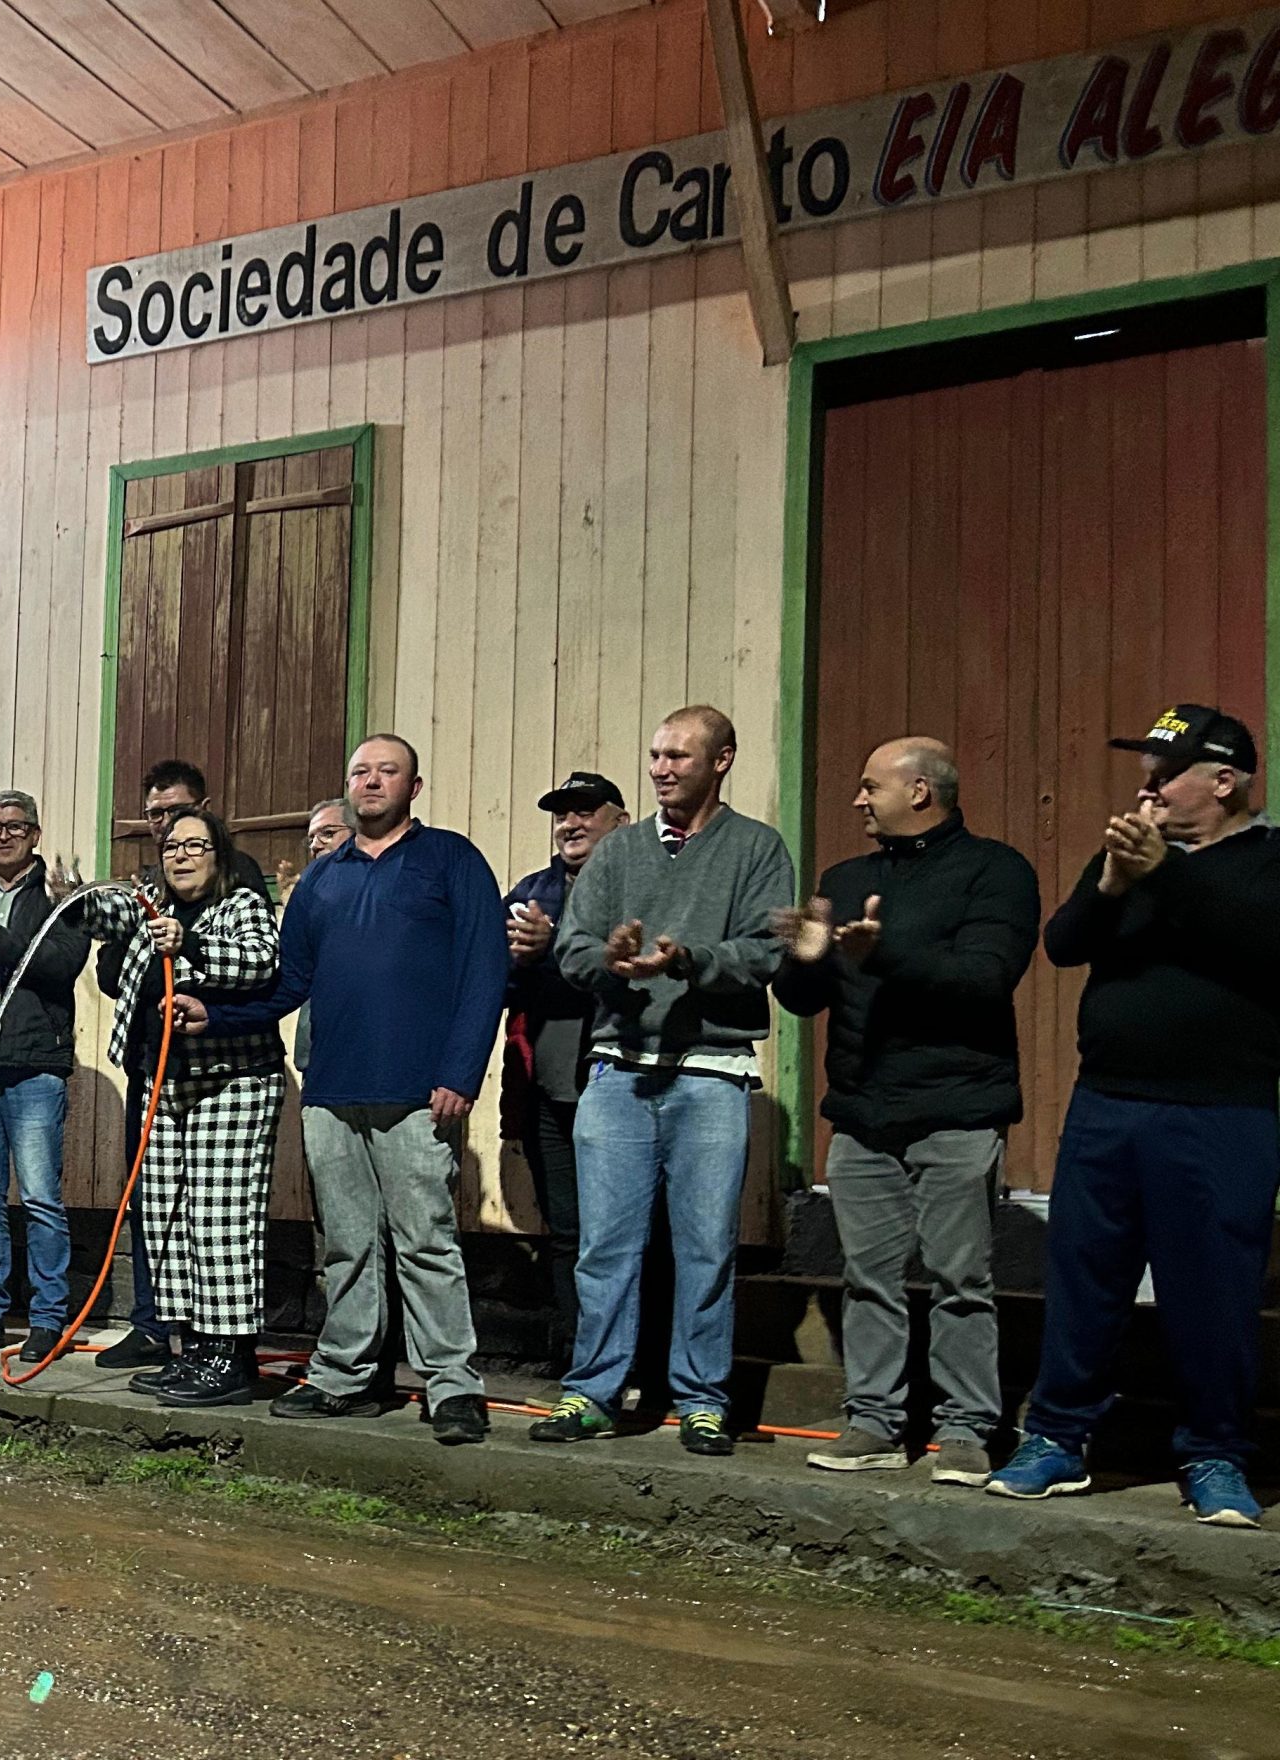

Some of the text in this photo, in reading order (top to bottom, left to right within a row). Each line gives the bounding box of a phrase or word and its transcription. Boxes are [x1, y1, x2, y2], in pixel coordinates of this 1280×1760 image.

[93, 207, 445, 355] Sociedade
[487, 181, 586, 278] de
[872, 72, 1025, 207] EIA
